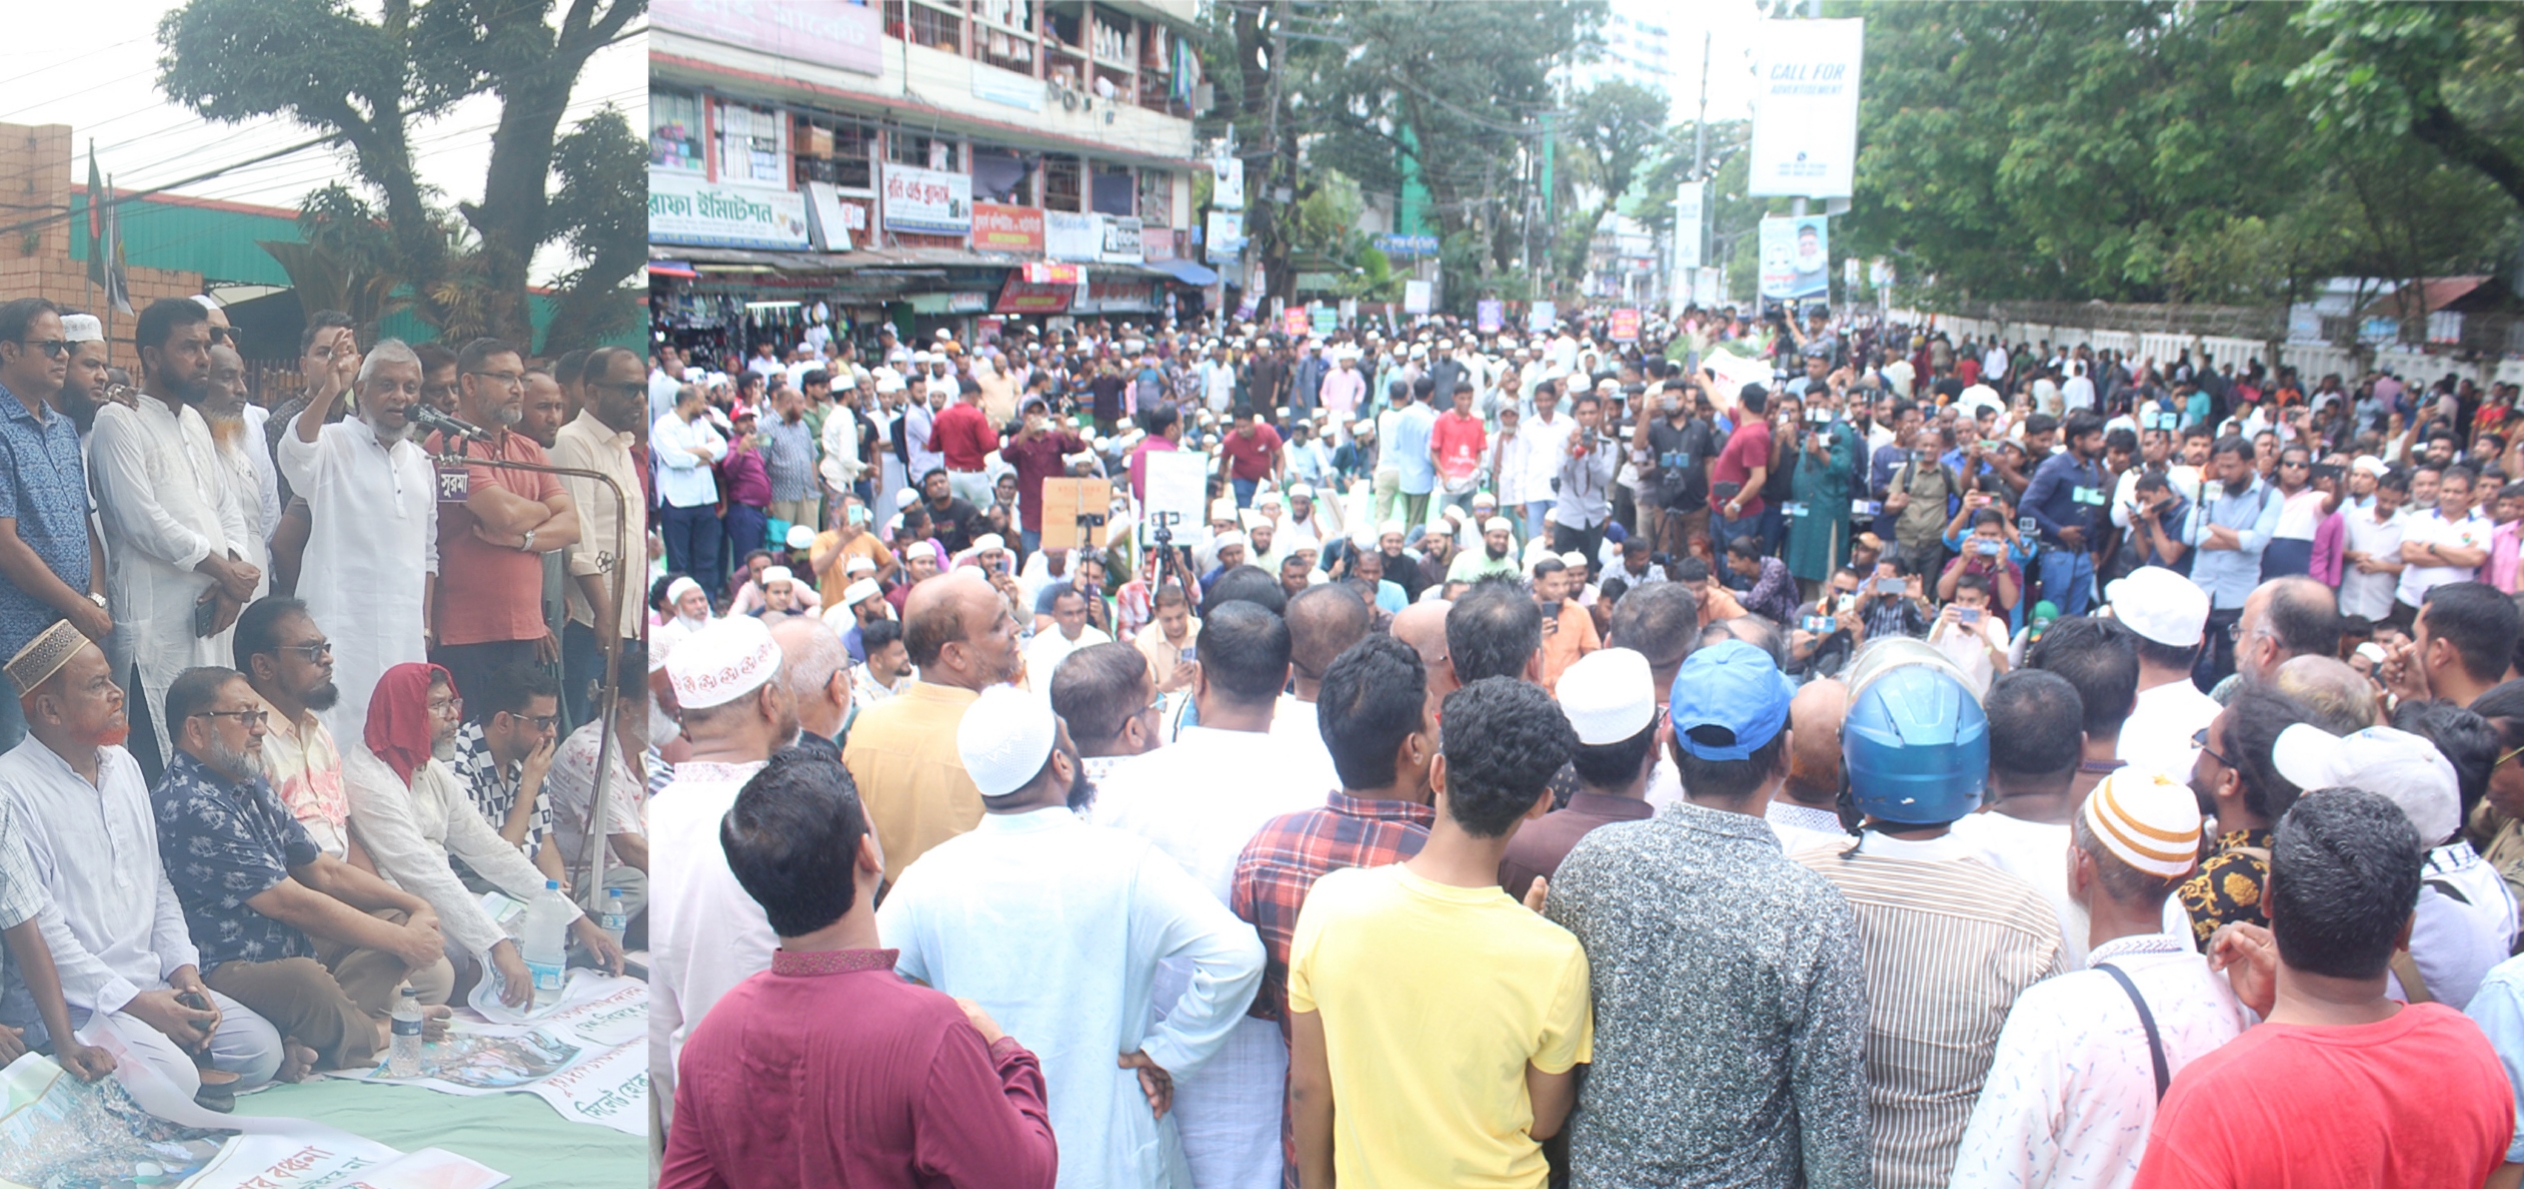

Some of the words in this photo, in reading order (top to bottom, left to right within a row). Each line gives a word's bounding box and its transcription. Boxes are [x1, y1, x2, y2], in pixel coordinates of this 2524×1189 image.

[1770, 63, 1806, 81] CALL
[1813, 63, 1846, 81] FOR
[1770, 84, 1844, 96] ADVERTISEMENT
[440, 472, 468, 498] সুরমা
[574, 1088, 630, 1120] সিলেট
[264, 1145, 335, 1179] বঞ্চনা
[341, 1156, 378, 1170] না
